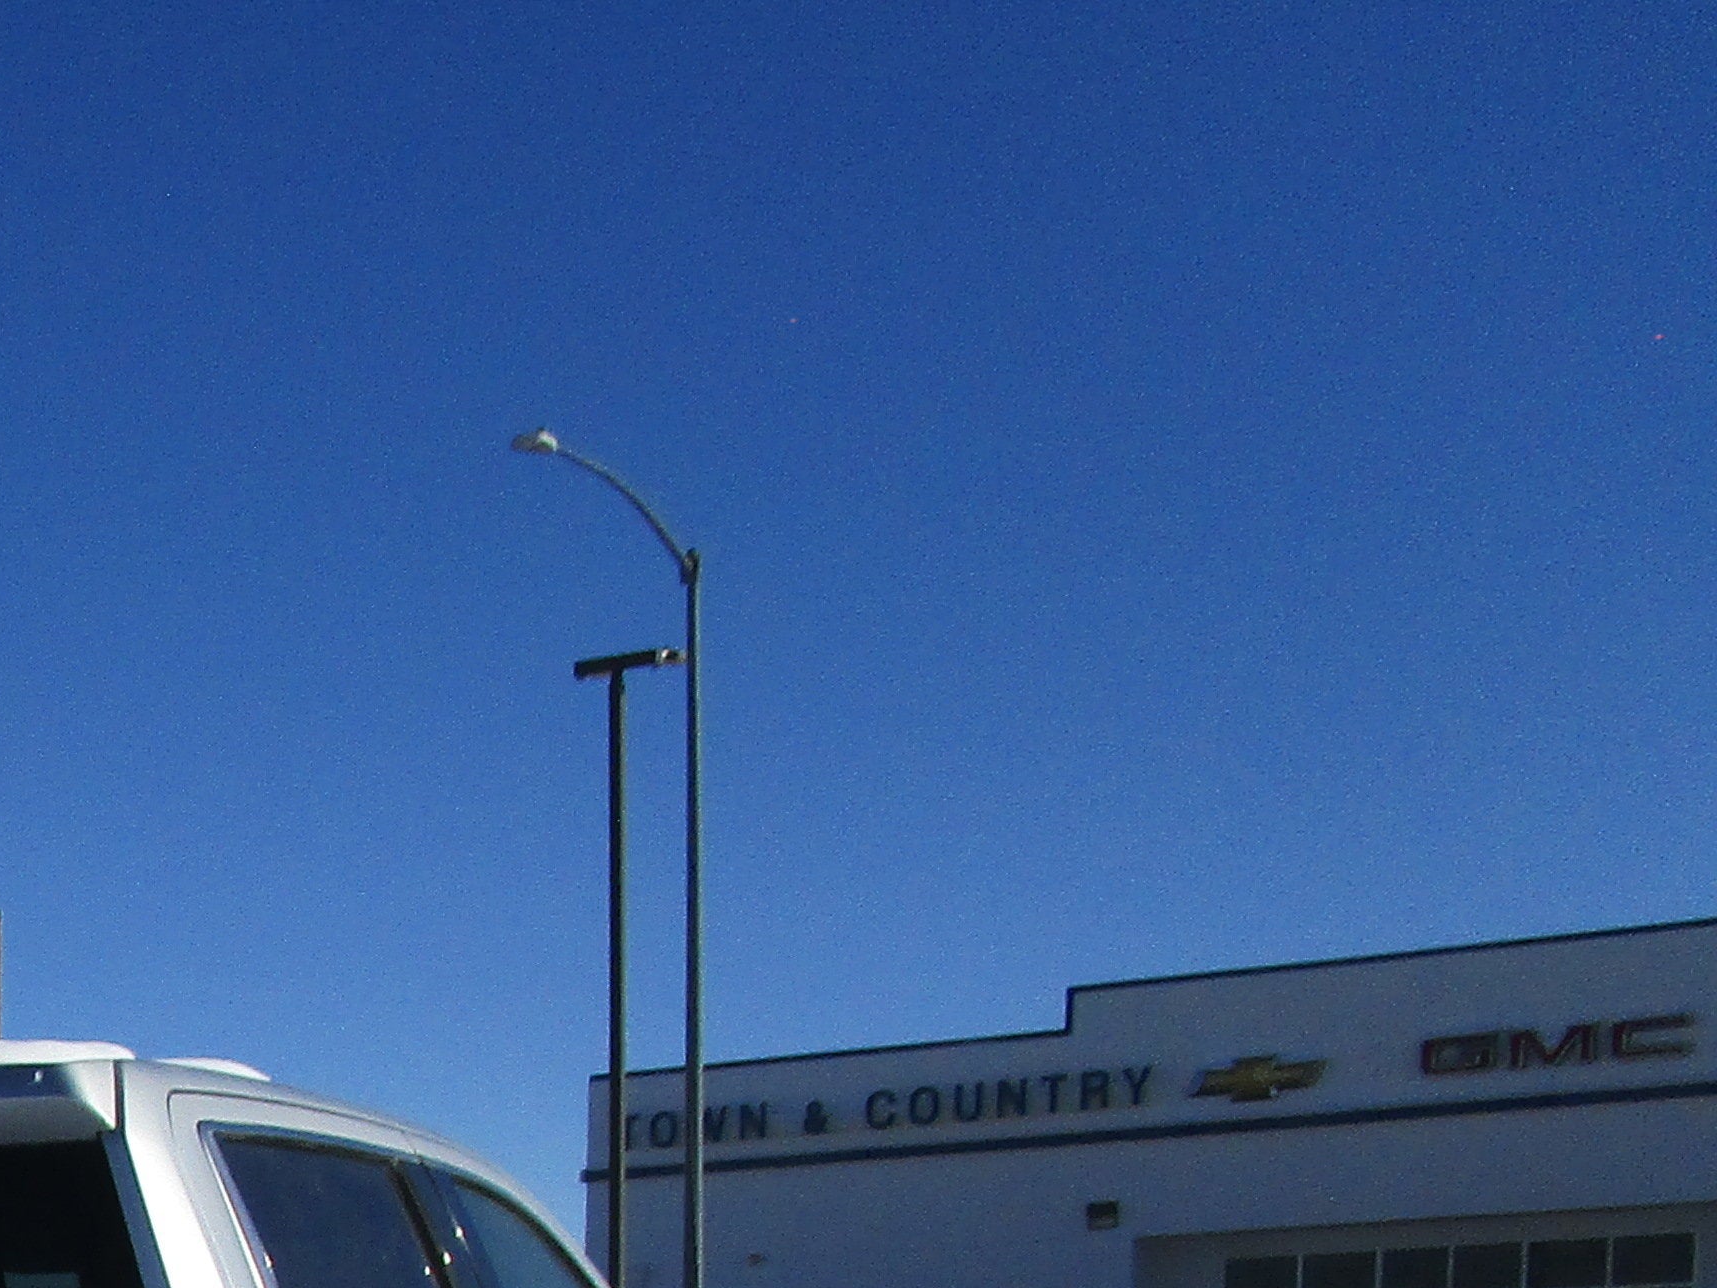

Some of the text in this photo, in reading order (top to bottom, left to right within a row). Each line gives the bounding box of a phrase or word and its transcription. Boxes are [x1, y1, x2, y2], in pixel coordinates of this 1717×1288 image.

[1421, 1012, 1696, 1075] GMC
[803, 1099, 831, 1136] &
[865, 1063, 1155, 1131] COUNTRY
